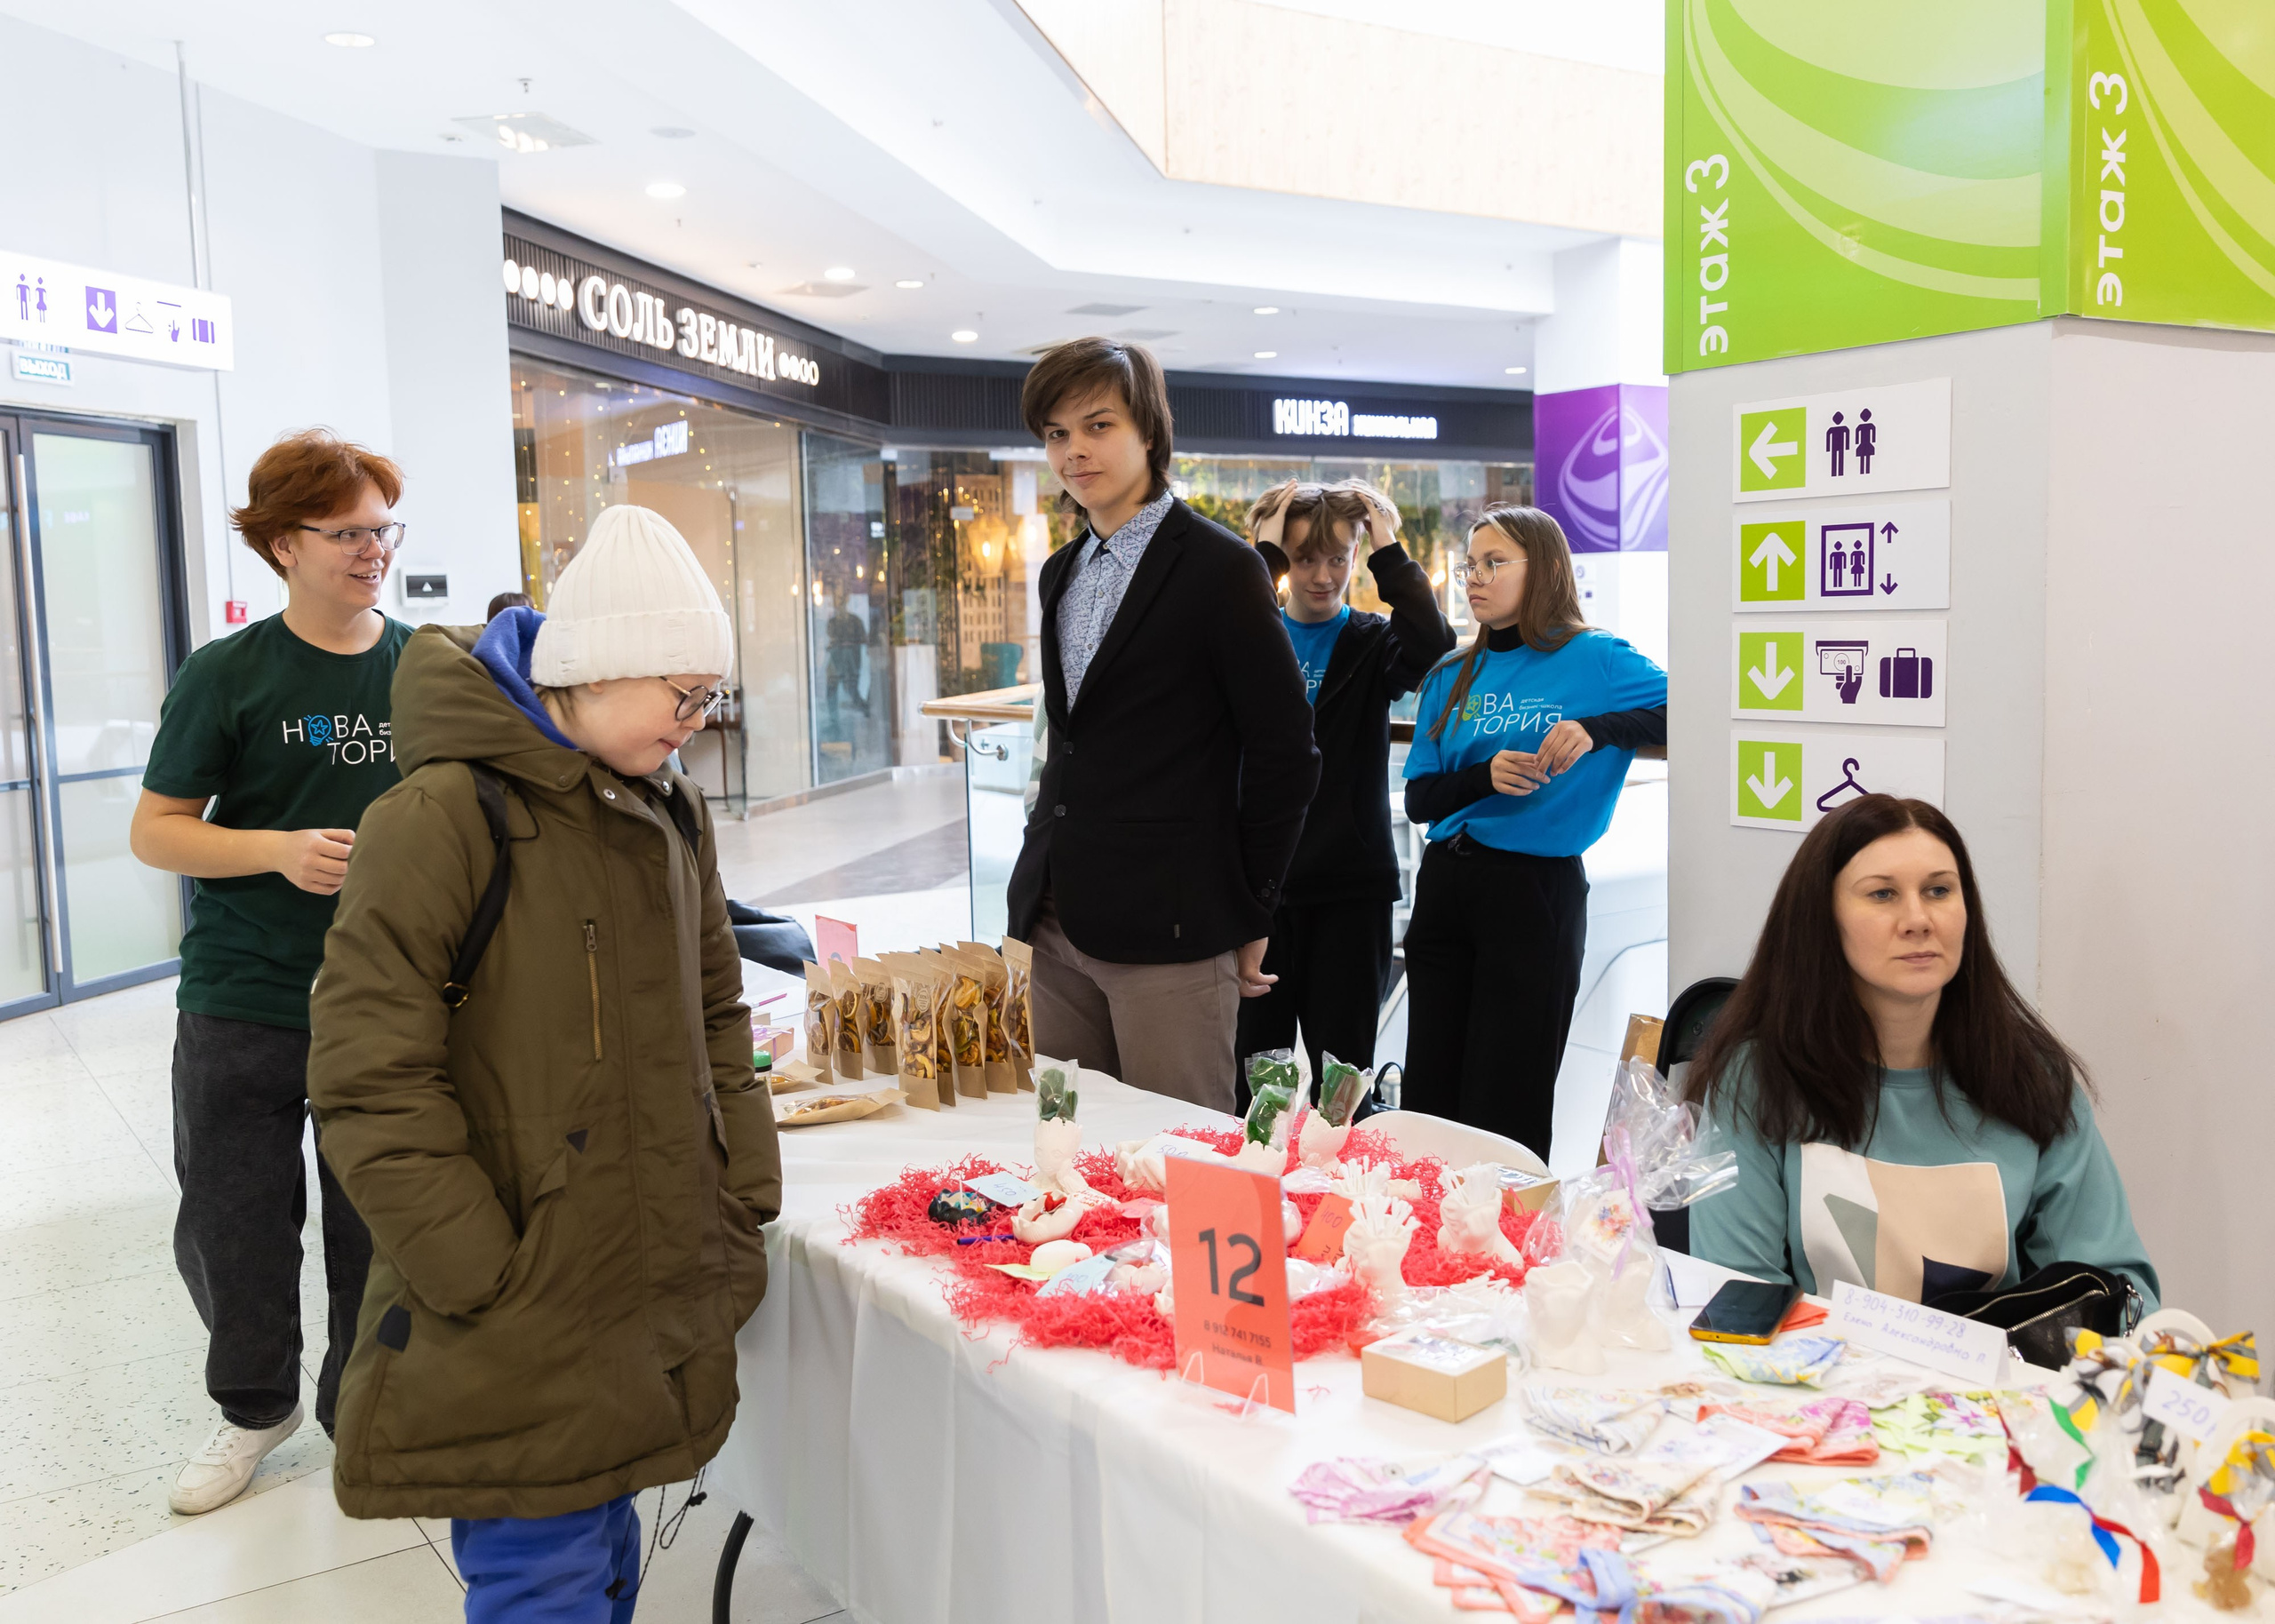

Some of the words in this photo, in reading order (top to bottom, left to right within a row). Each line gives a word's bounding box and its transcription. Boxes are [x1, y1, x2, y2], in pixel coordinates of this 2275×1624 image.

[2088, 71, 2128, 115] 3
[1685, 154, 1730, 194] 3
[2097, 128, 2127, 307] этаж
[1699, 197, 1729, 356] этаж
[579, 275, 674, 350] СОЛЬ
[678, 306, 777, 381] ЗЕМЛИ
[20, 357, 68, 380] ВЫХОД
[1273, 398, 1350, 436] КИНЗА
[1473, 712, 1562, 737] ТОРИЯ
[1198, 1227, 1265, 1307] 12
